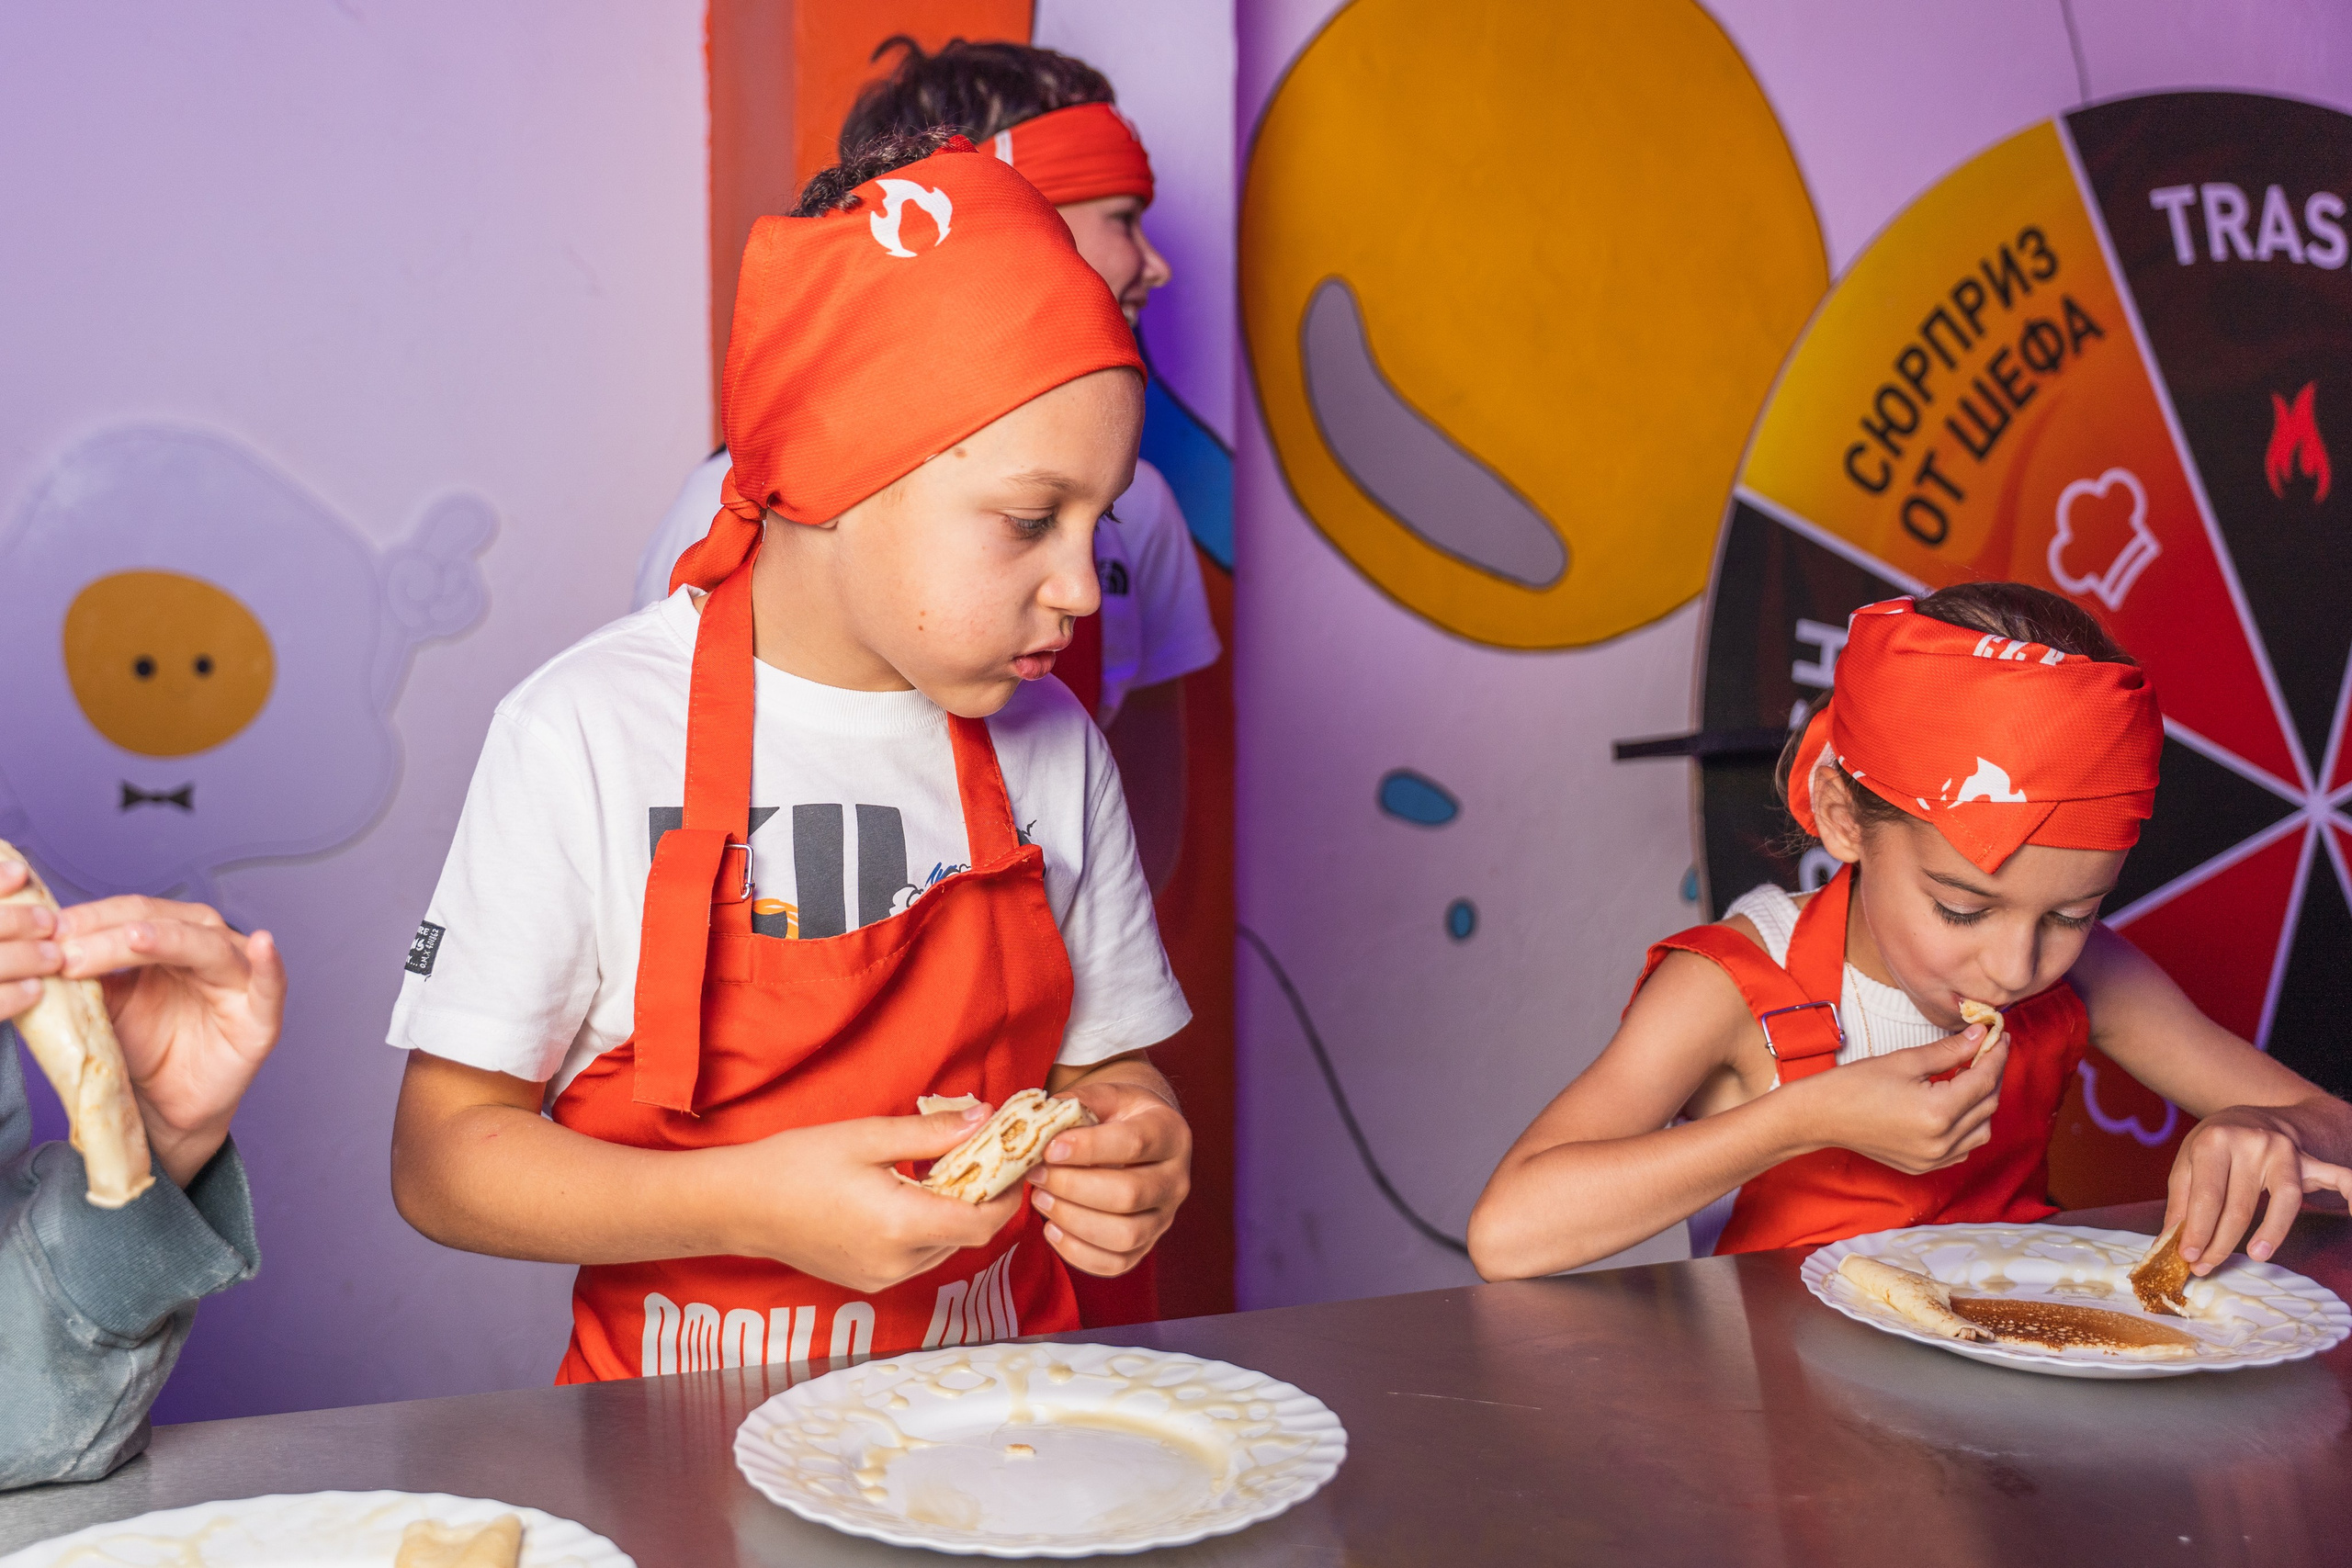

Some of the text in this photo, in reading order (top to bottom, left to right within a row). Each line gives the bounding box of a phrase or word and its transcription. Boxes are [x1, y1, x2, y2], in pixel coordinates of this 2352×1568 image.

[2148, 182, 2350, 270] TRAS
[1842, 226, 2060, 497] СЮРПРИЗ
[1898, 292, 2107, 549] ОТ ШЕФА
